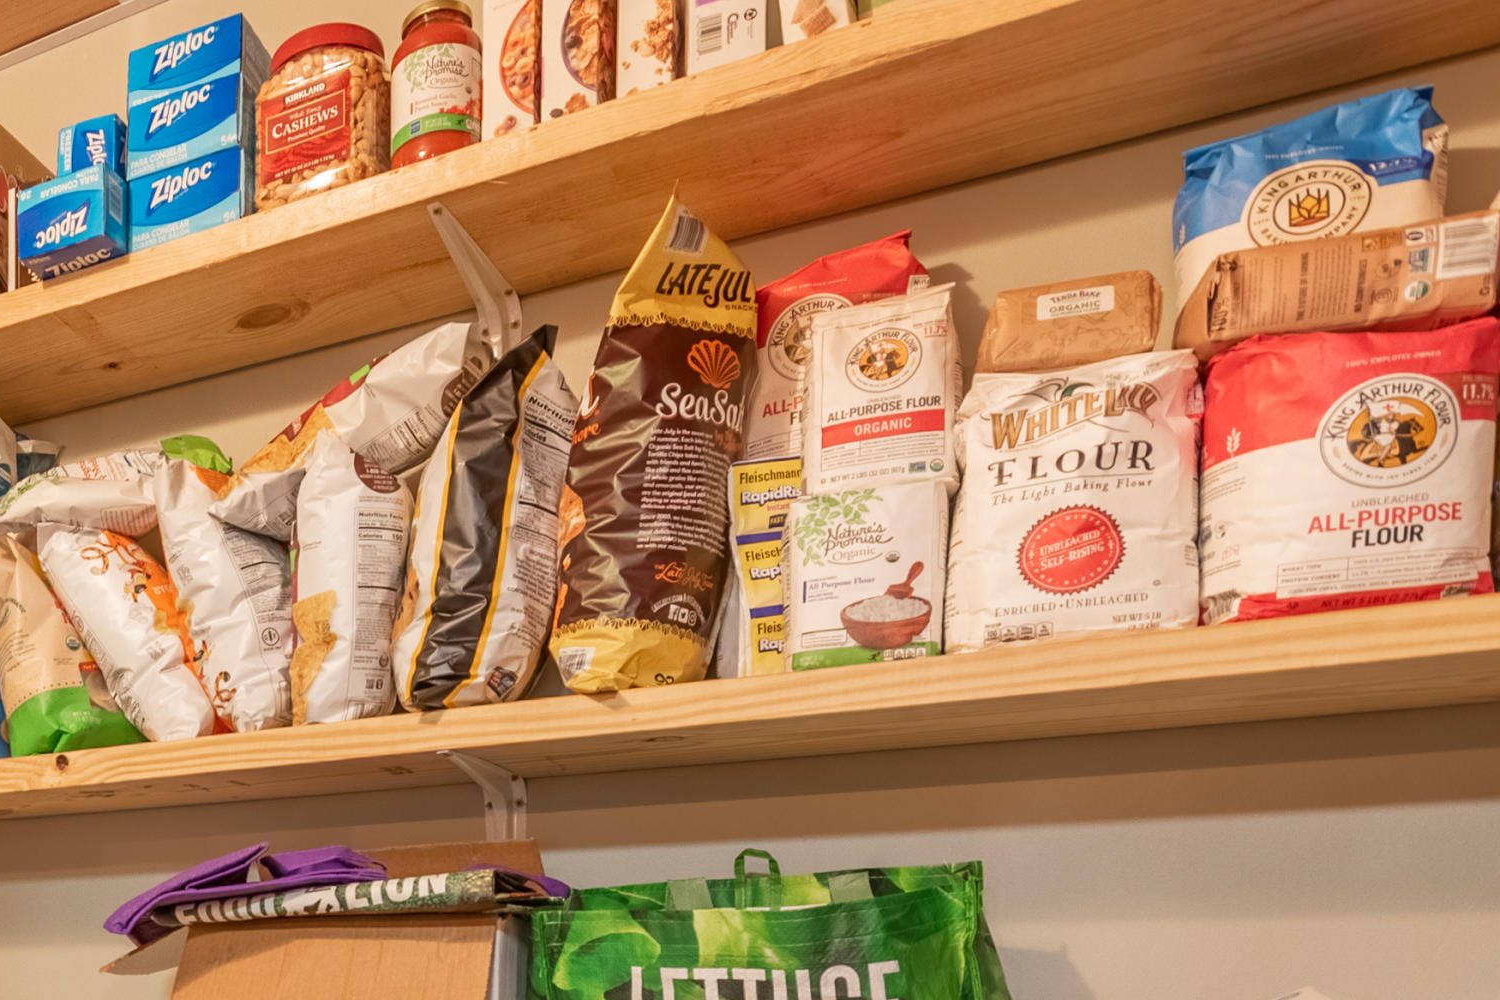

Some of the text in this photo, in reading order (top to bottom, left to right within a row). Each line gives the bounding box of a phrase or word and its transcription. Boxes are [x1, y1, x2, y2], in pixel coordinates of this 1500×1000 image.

[153, 26, 216, 75] Ziploc
[424, 66, 469, 83] Promise
[425, 55, 466, 73] Nature's
[429, 76, 461, 87] Organic
[285, 82, 326, 105] KIRKLAND
[149, 84, 211, 133] Ziploc
[272, 105, 338, 139] CASHEWS
[308, 125, 326, 138] Quality
[131, 143, 187, 170] PARA CONGELAR
[40, 180, 78, 199] CONGELAR
[150, 161, 212, 209] Ziploc
[1256, 170, 1362, 214] KING ARTHUR
[36, 206, 88, 249] Ziploc
[132, 219, 190, 244] PARA CONGELAR
[655, 262, 722, 297] LATE
[703, 268, 758, 309] JUL
[1049, 300, 1101, 313] ORGANIC
[771, 300, 835, 347] KING ARTHUR
[848, 329, 919, 366] KING ARTHUR FLOUR
[1346, 350, 1442, 369] 100% EMPLOYEE-OWNED
[1462, 384, 1496, 401] 11.7%
[527, 395, 576, 427] Nutrition
[827, 396, 942, 423] ALL-PURPOSE FLOUR
[989, 392, 1102, 450] WHITE
[1325, 382, 1452, 441] KING ARTHUR FLOUR
[854, 417, 912, 436] ORGANIC
[649, 443, 670, 452] Organic
[668, 451, 684, 460] Chips
[659, 459, 679, 467] friends
[988, 440, 1155, 487] FLOUR
[741, 486, 803, 505] RapidRis
[991, 478, 1153, 506] The Light Baking Flour
[1351, 492, 1429, 508] UNBLEACHED
[358, 511, 387, 519] Nutrition
[1308, 502, 1463, 534] ALL-PURPOSE
[827, 523, 887, 541] Nature's
[1039, 530, 1101, 556] UNBLEACHED
[1351, 524, 1423, 548] FLOUR
[822, 535, 893, 556] Promise
[832, 547, 876, 561] Organic
[1040, 543, 1106, 571] SELF-RISING
[808, 577, 875, 591] All Purpose Flour
[1310, 573, 1341, 582] CONTENT
[995, 593, 1149, 618] ENRICHED UNBLEACHED
[1112, 615, 1128, 624] NET
